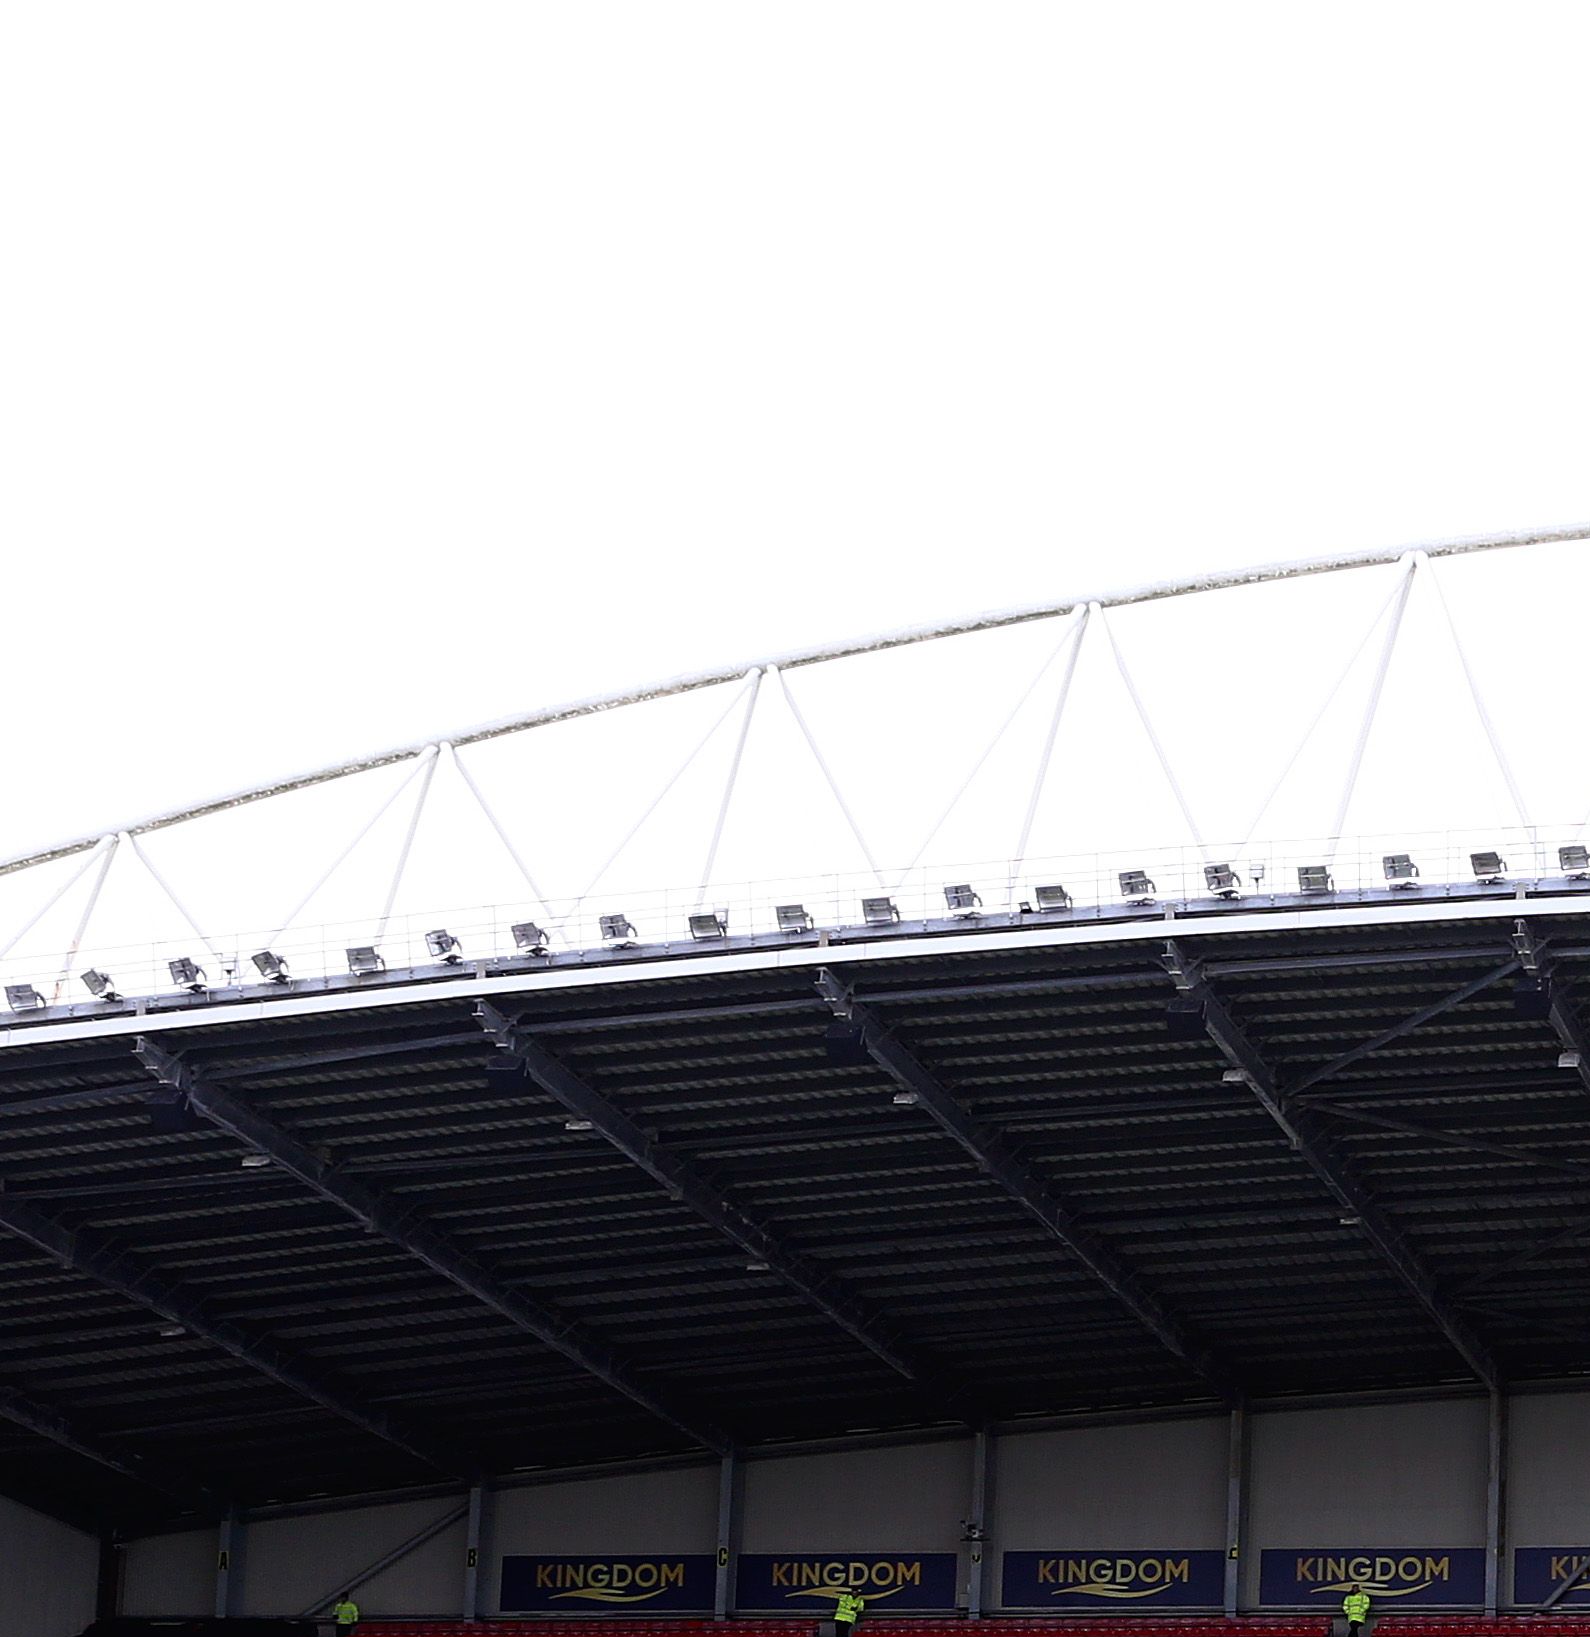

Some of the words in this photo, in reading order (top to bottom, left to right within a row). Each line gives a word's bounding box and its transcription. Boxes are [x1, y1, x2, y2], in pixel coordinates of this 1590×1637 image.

[218, 1551, 228, 1570] A
[467, 1548, 477, 1567] B
[716, 1547, 728, 1566] C
[536, 1563, 685, 1588] KINGDOM
[772, 1562, 921, 1586] KINGDOM
[1039, 1558, 1189, 1583] KINGDOM
[1297, 1557, 1449, 1581] KINGDOM
